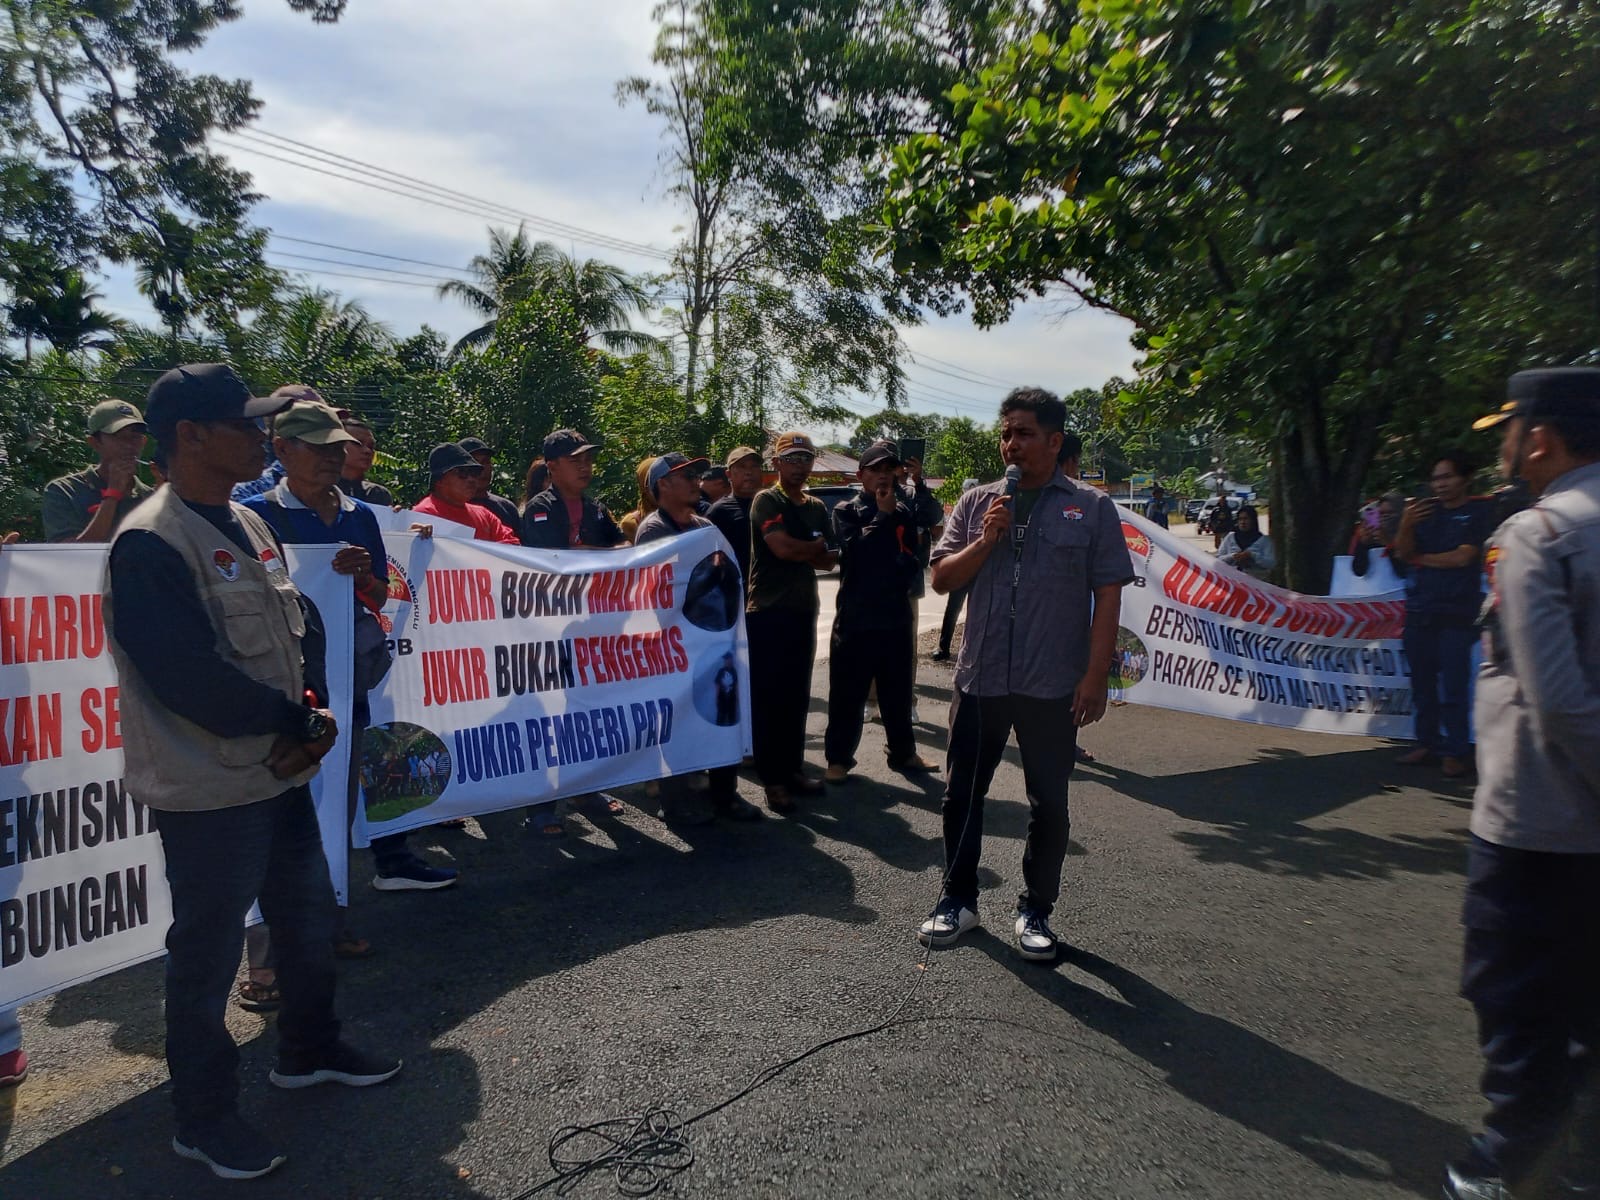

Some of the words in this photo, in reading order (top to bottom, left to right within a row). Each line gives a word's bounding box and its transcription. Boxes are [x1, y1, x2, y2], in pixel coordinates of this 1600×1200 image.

[406, 579, 420, 630] BENGKULU
[426, 569, 496, 624] JUKIR
[502, 571, 592, 619] BUKAN
[587, 563, 674, 614] MALING
[1163, 555, 1277, 625] ALIANSI
[1, 594, 113, 665] HARU
[1145, 605, 1220, 650] BERSATU
[422, 647, 490, 706] JUKIR
[495, 638, 574, 697] BUKAN
[575, 625, 688, 686] PENGEMIS
[1152, 650, 1219, 692] PARKIR
[1219, 664, 1243, 696] SE
[1245, 669, 1287, 705] KOTA
[454, 721, 525, 784] JUKIR
[527, 705, 630, 770] PEMBERI
[633, 698, 674, 750] PAD
[2, 864, 148, 968] BUNGAN
